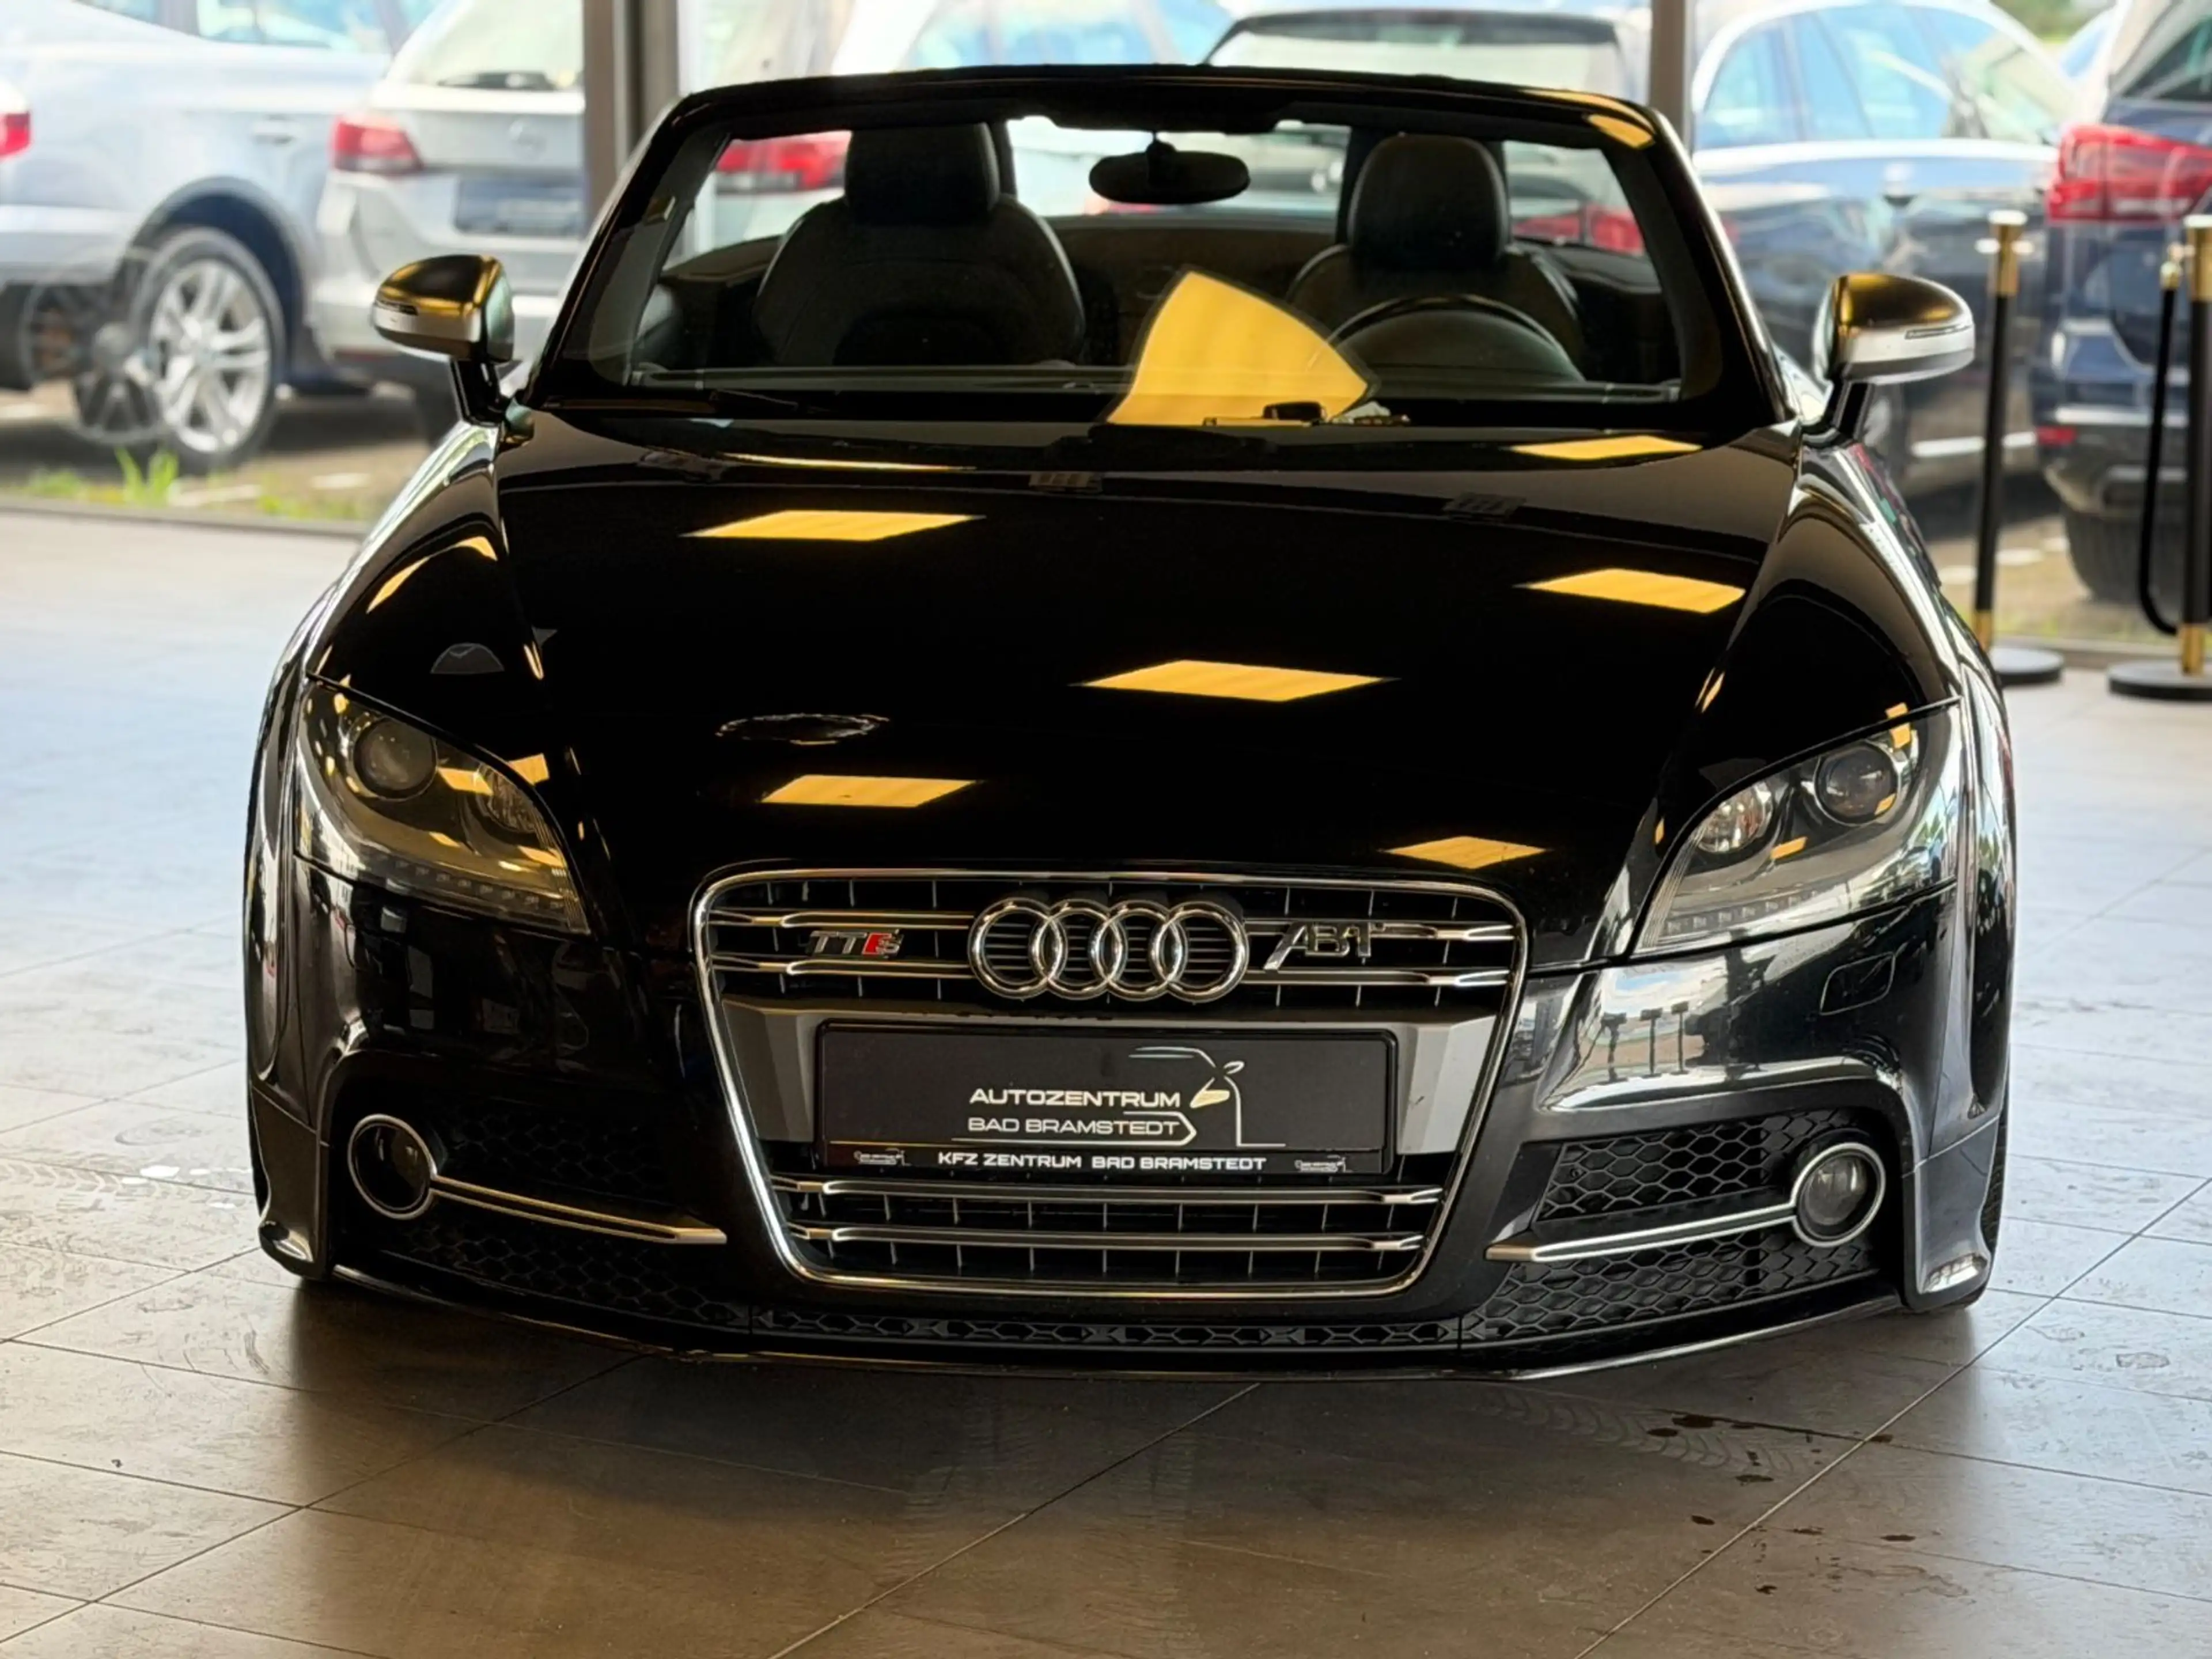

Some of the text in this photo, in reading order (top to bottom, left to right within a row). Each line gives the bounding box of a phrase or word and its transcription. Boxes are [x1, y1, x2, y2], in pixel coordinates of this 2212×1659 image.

[969, 1088, 1180, 1108] AUTOZENTRUM
[968, 1118, 1180, 1135] BAD BRAMSTEDT
[938, 1152, 1266, 1171] KFZ ZENTRUM BAD BRAMSTEDT
